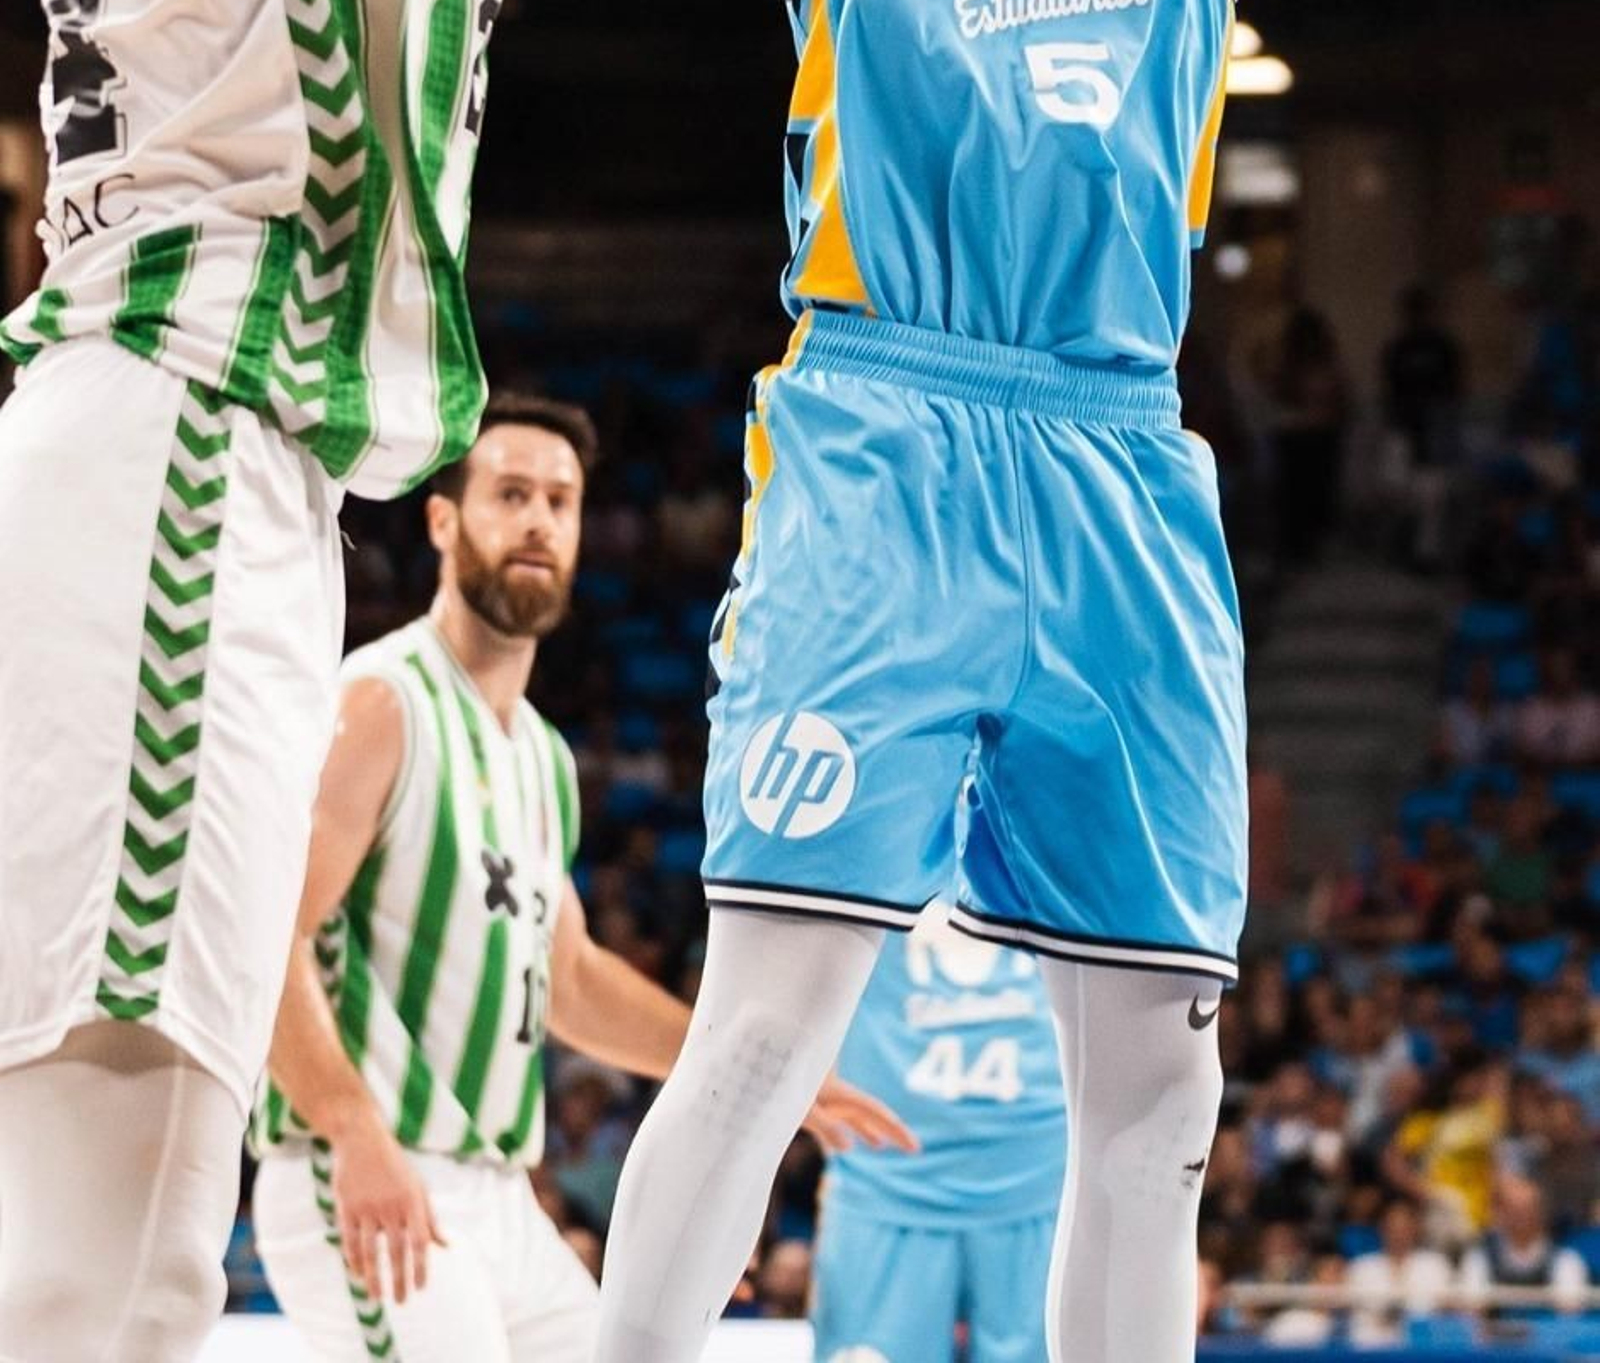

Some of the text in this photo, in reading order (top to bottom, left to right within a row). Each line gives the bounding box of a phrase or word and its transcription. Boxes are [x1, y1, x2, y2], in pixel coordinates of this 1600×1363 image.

[1024, 42, 1121, 132] 5
[748, 710, 846, 838] hp
[905, 1036, 1023, 1102] 44
